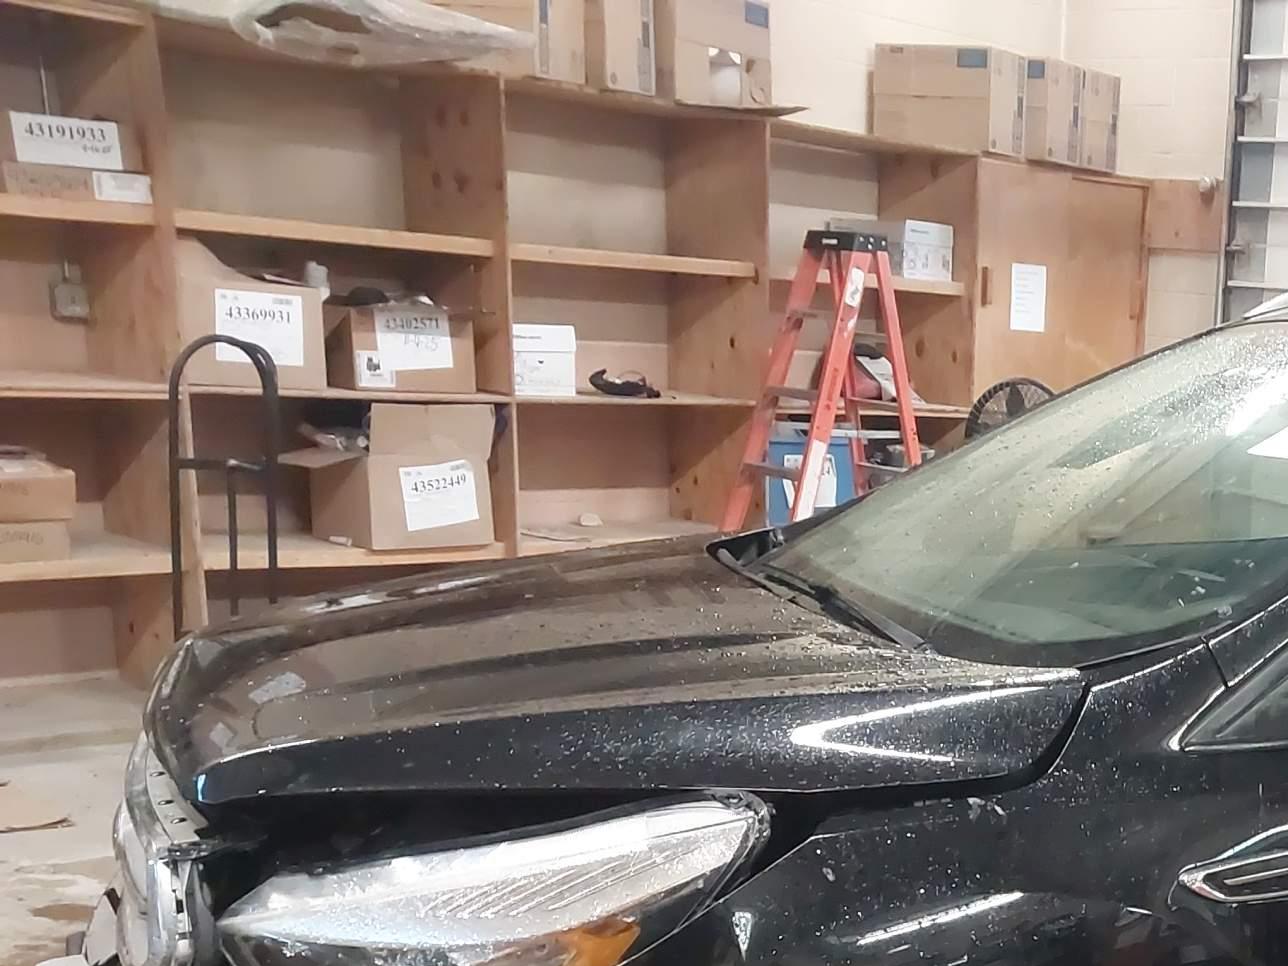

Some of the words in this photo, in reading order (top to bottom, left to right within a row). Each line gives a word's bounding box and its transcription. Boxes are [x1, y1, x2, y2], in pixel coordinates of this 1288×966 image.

[24, 121, 106, 142] 43191933
[225, 305, 291, 324] 43369931
[384, 317, 440, 330] 43402571
[410, 473, 467, 493] 43522449
